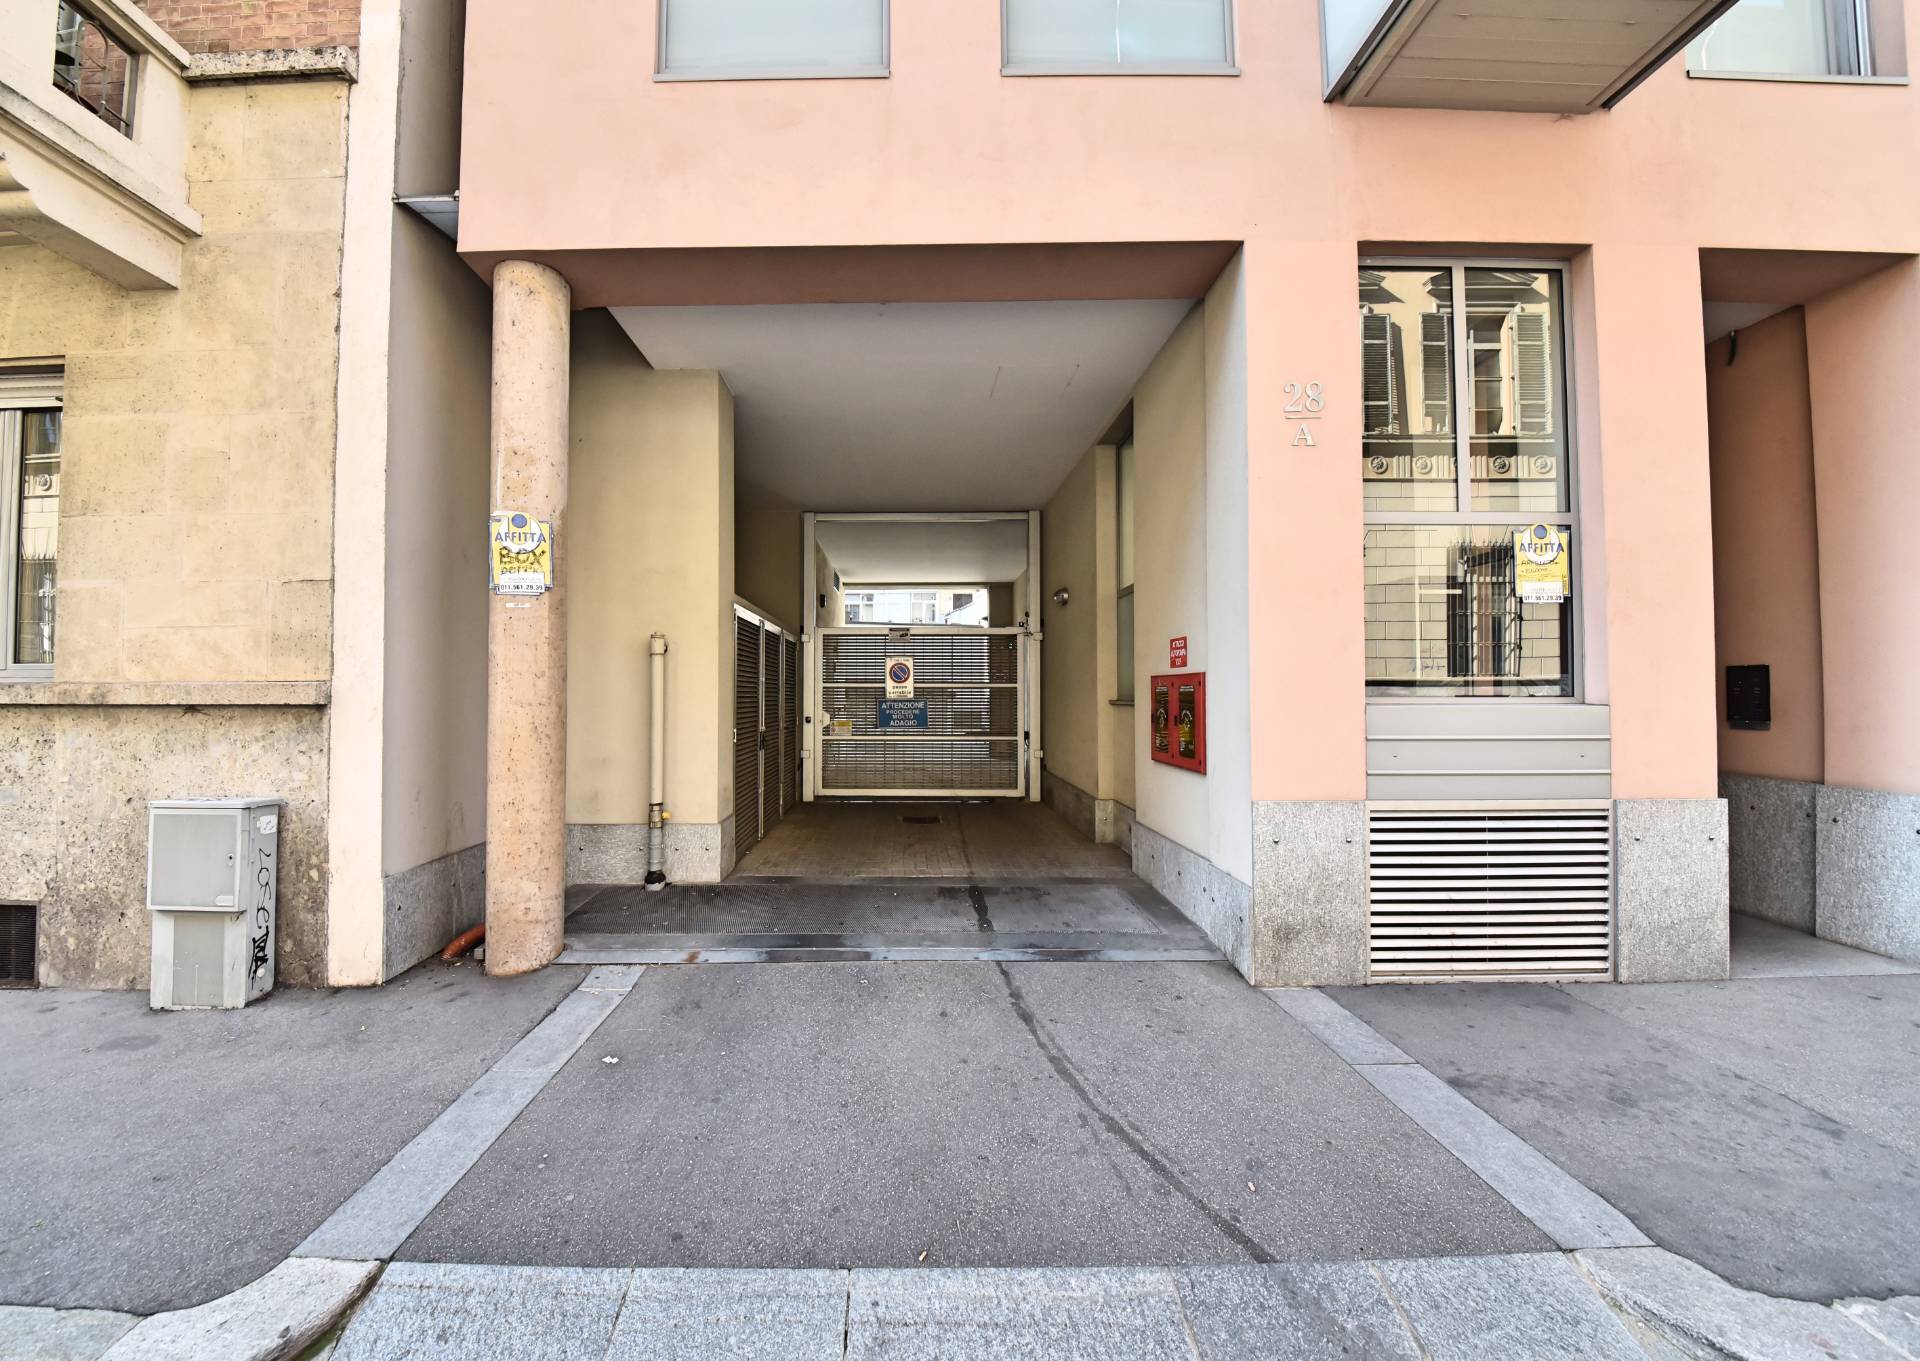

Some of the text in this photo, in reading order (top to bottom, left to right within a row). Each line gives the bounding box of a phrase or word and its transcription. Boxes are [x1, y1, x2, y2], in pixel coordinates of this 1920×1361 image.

[1283, 381, 1325, 413] 28
[1291, 423, 1317, 447] A
[495, 531, 547, 543] AFFITTA
[1519, 542, 1565, 553] AFFITTA
[499, 545, 547, 568] BOX
[881, 701, 925, 709] ATTENZIONE
